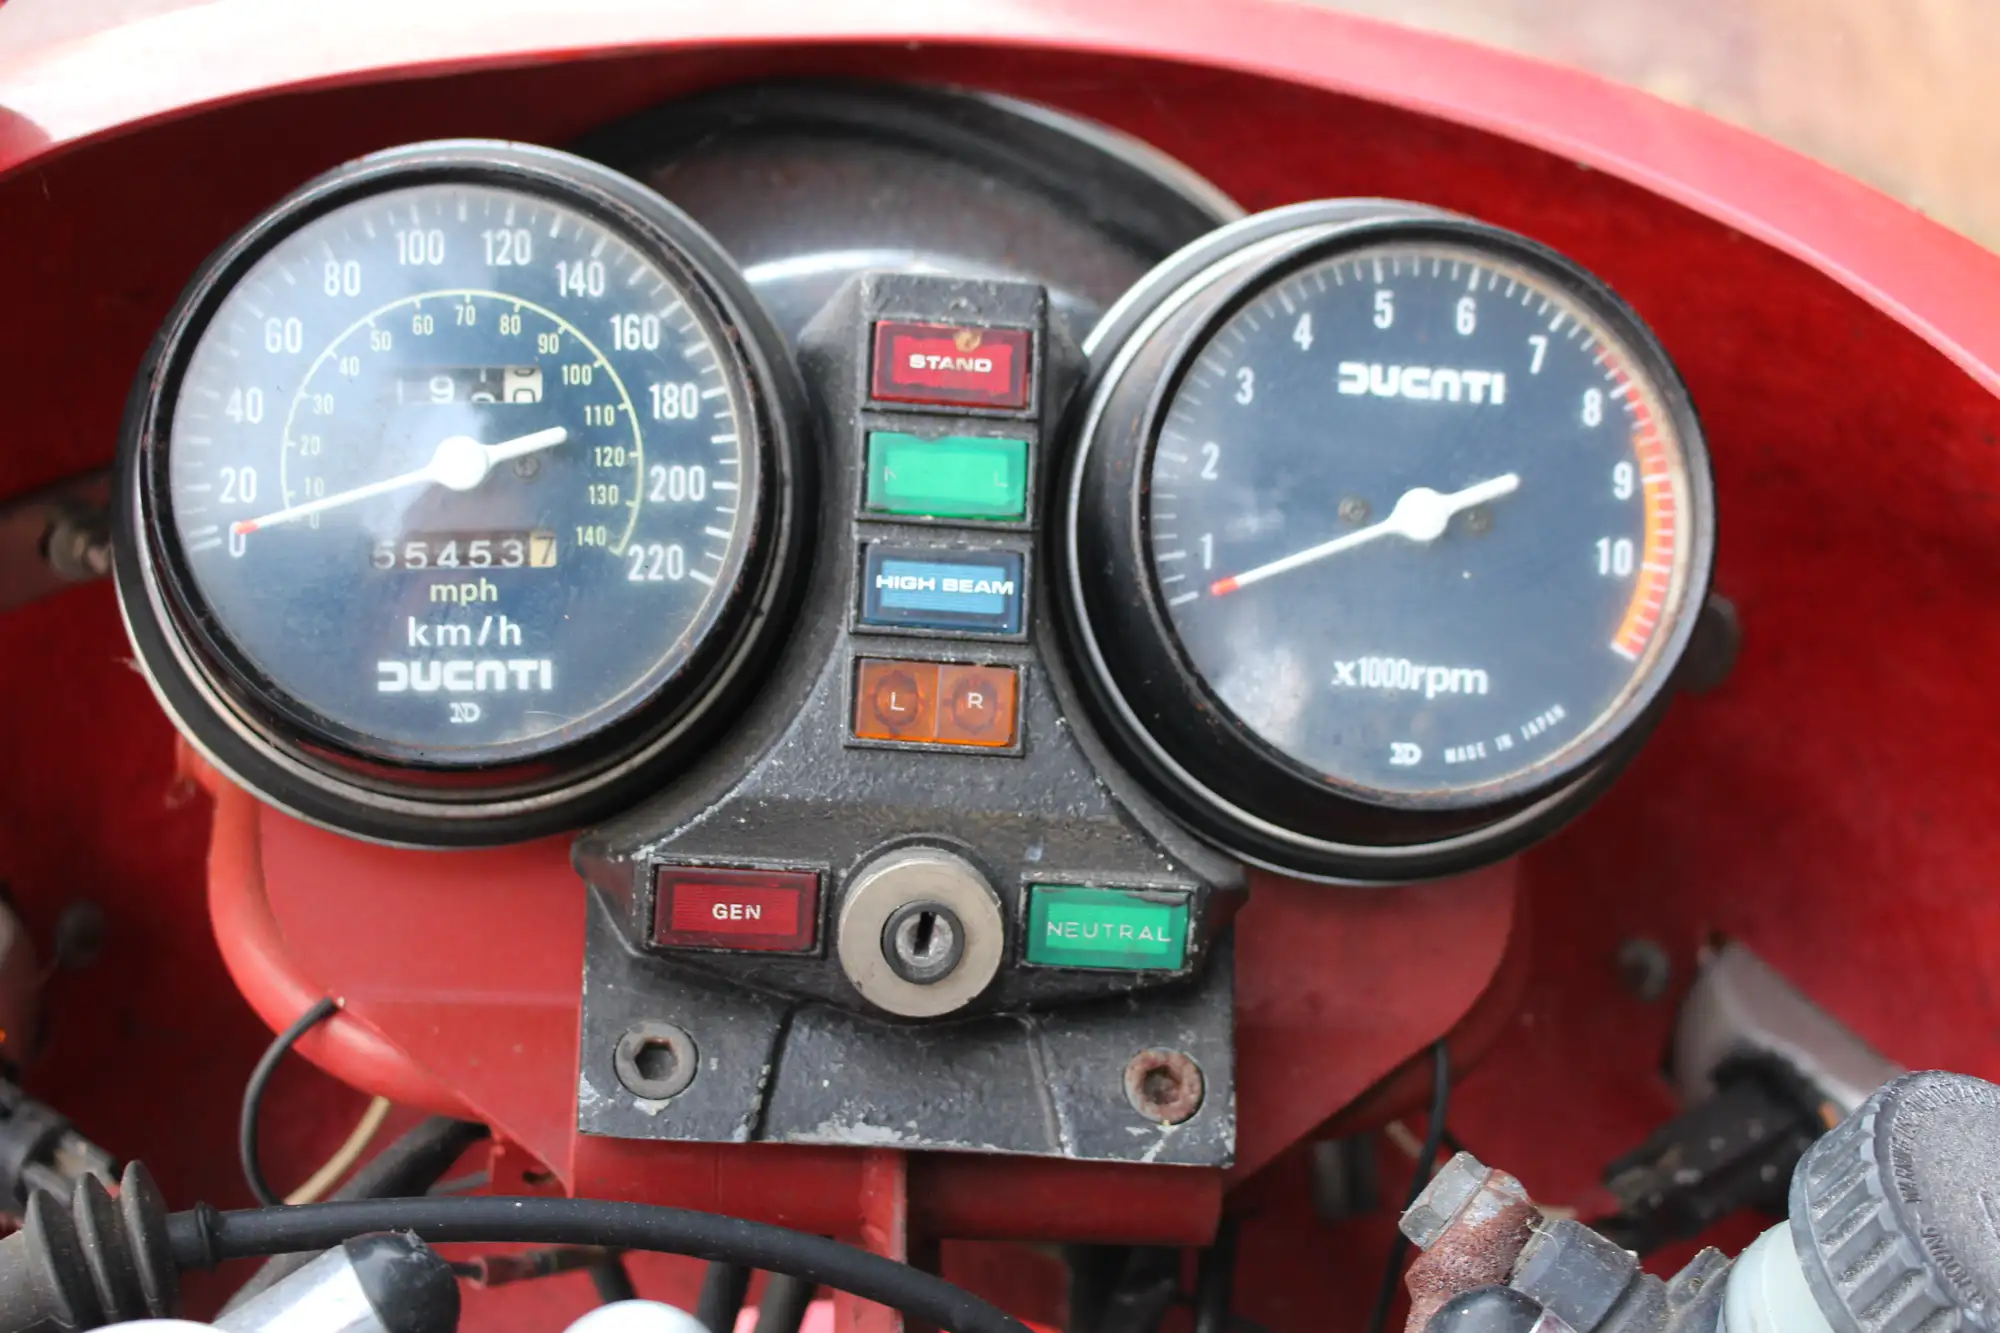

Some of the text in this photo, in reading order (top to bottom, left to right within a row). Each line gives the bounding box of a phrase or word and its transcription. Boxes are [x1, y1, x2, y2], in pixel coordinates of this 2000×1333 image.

[397, 229, 444, 265] 100
[481, 228, 532, 266] 120
[324, 260, 361, 297] 80
[555, 261, 605, 297] 140
[412, 314, 433, 336] 60
[455, 305, 475, 325] 70
[500, 314, 520, 335] 80
[1373, 290, 1394, 329] 5
[1456, 296, 1476, 335] 6
[264, 317, 303, 353] 60
[371, 331, 391, 351] 50
[538, 333, 559, 354] 90
[610, 313, 660, 350] 160
[1292, 313, 1313, 350] 4
[339, 357, 359, 377] 40
[909, 354, 992, 374] STAND
[1528, 334, 1547, 374] 7
[562, 365, 592, 385] 100
[1235, 367, 1254, 405] 3
[1338, 361, 1506, 405] DUCATI
[225, 386, 263, 424] 40
[312, 393, 334, 415] 30
[585, 405, 614, 426] 110
[649, 382, 699, 419] 180
[1582, 388, 1602, 427] 8
[300, 434, 320, 456] 20
[595, 447, 625, 467] 120
[1201, 442, 1220, 480] 2
[219, 466, 257, 503] 20
[305, 476, 324, 497] 10
[589, 485, 619, 505] 130
[649, 466, 706, 502] 200
[1613, 461, 1633, 500] 9
[229, 521, 246, 557] 0
[576, 526, 606, 546] 140
[1201, 532, 1213, 570] 1
[628, 545, 684, 581] 220
[1595, 537, 1633, 577] 10
[430, 577, 498, 606] mph
[876, 574, 1014, 595] HIGH BEAM
[408, 615, 522, 647] km/h
[377, 660, 553, 691] DUCATI
[890, 691, 905, 711] L
[967, 692, 984, 709] R
[1444, 703, 1566, 765] MADE IN JAPAN
[712, 903, 761, 920] GEN
[1047, 921, 1172, 942] NEUTRAL
